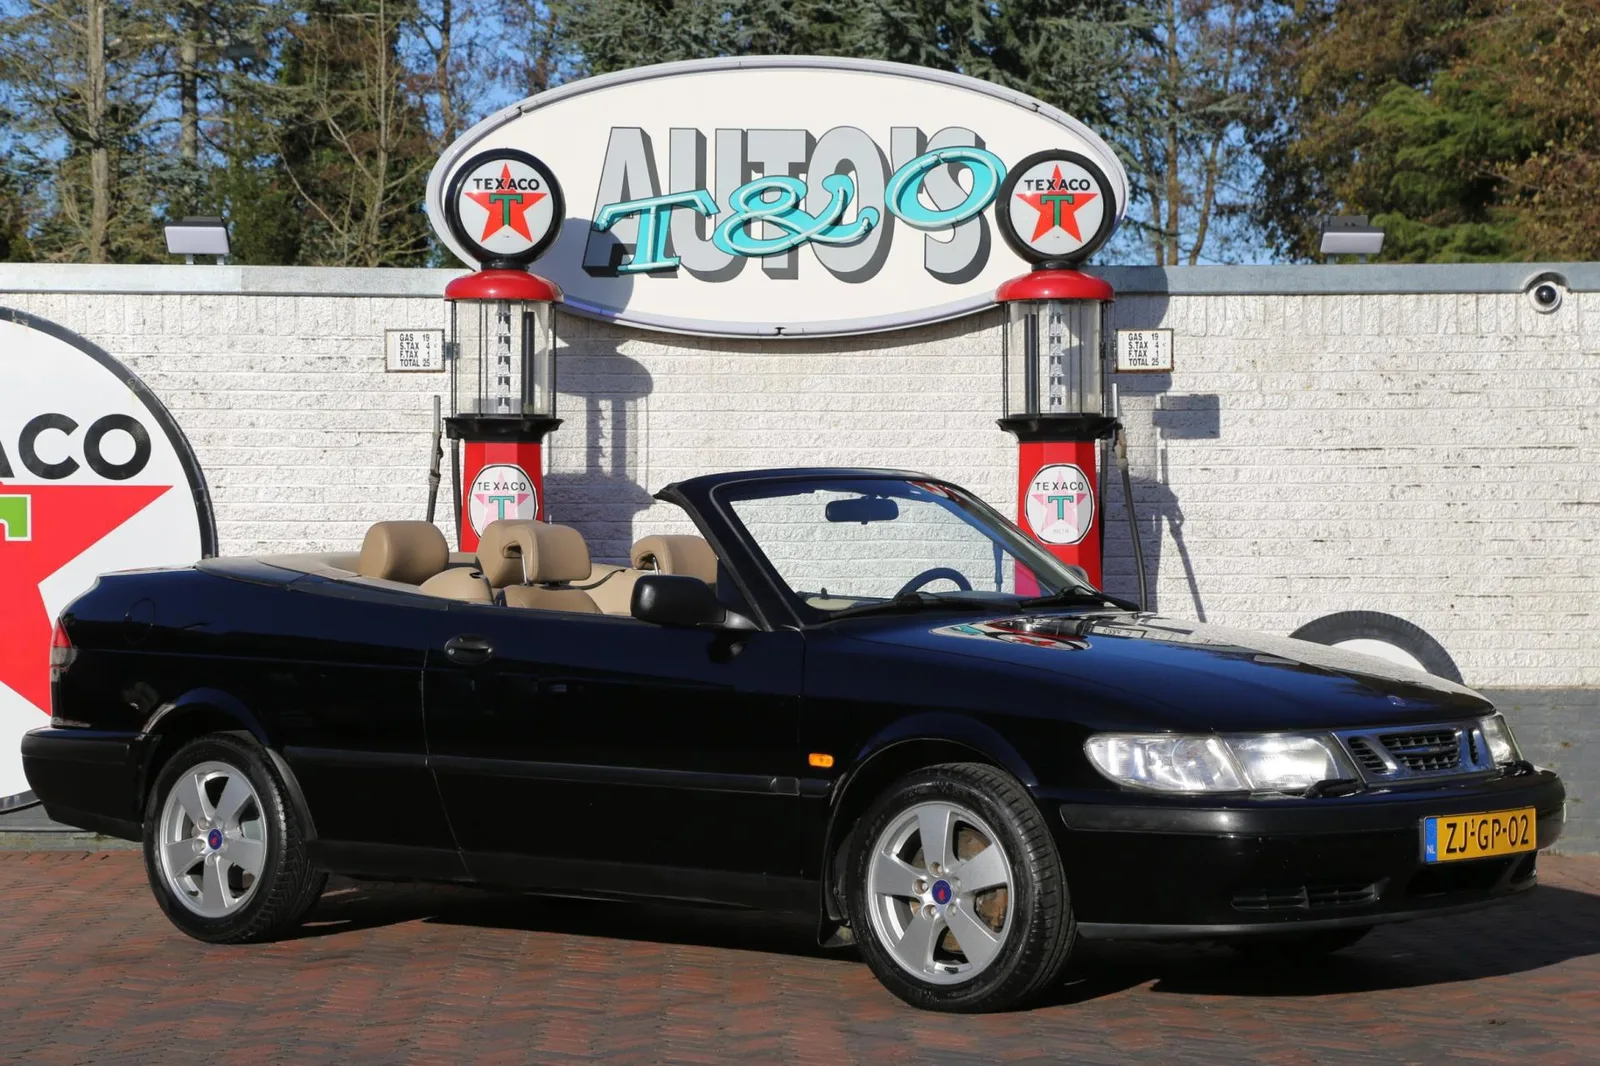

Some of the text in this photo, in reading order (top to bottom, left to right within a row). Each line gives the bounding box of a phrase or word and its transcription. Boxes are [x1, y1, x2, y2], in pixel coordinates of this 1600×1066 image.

[473, 178, 540, 191] TEXACO
[1024, 179, 1091, 191] TEXACO
[582, 125, 991, 284] AUTO'S
[399, 333, 430, 341] GAS 19
[1128, 333, 1159, 341] GAS 19
[399, 342, 430, 350] S.TAX 4
[1128, 341, 1159, 349] S.TAX 4
[399, 350, 418, 358] F.TAX
[1128, 350, 1148, 358] F.TAX
[400, 359, 430, 367] TOTAL 25
[1128, 358, 1159, 366] TOTAL 25
[0, 413, 152, 480] CO
[477, 482, 526, 491] TEXACO
[1035, 481, 1084, 491] TEXACO
[1426, 814, 1529, 854] NL ZJ-GP-02
